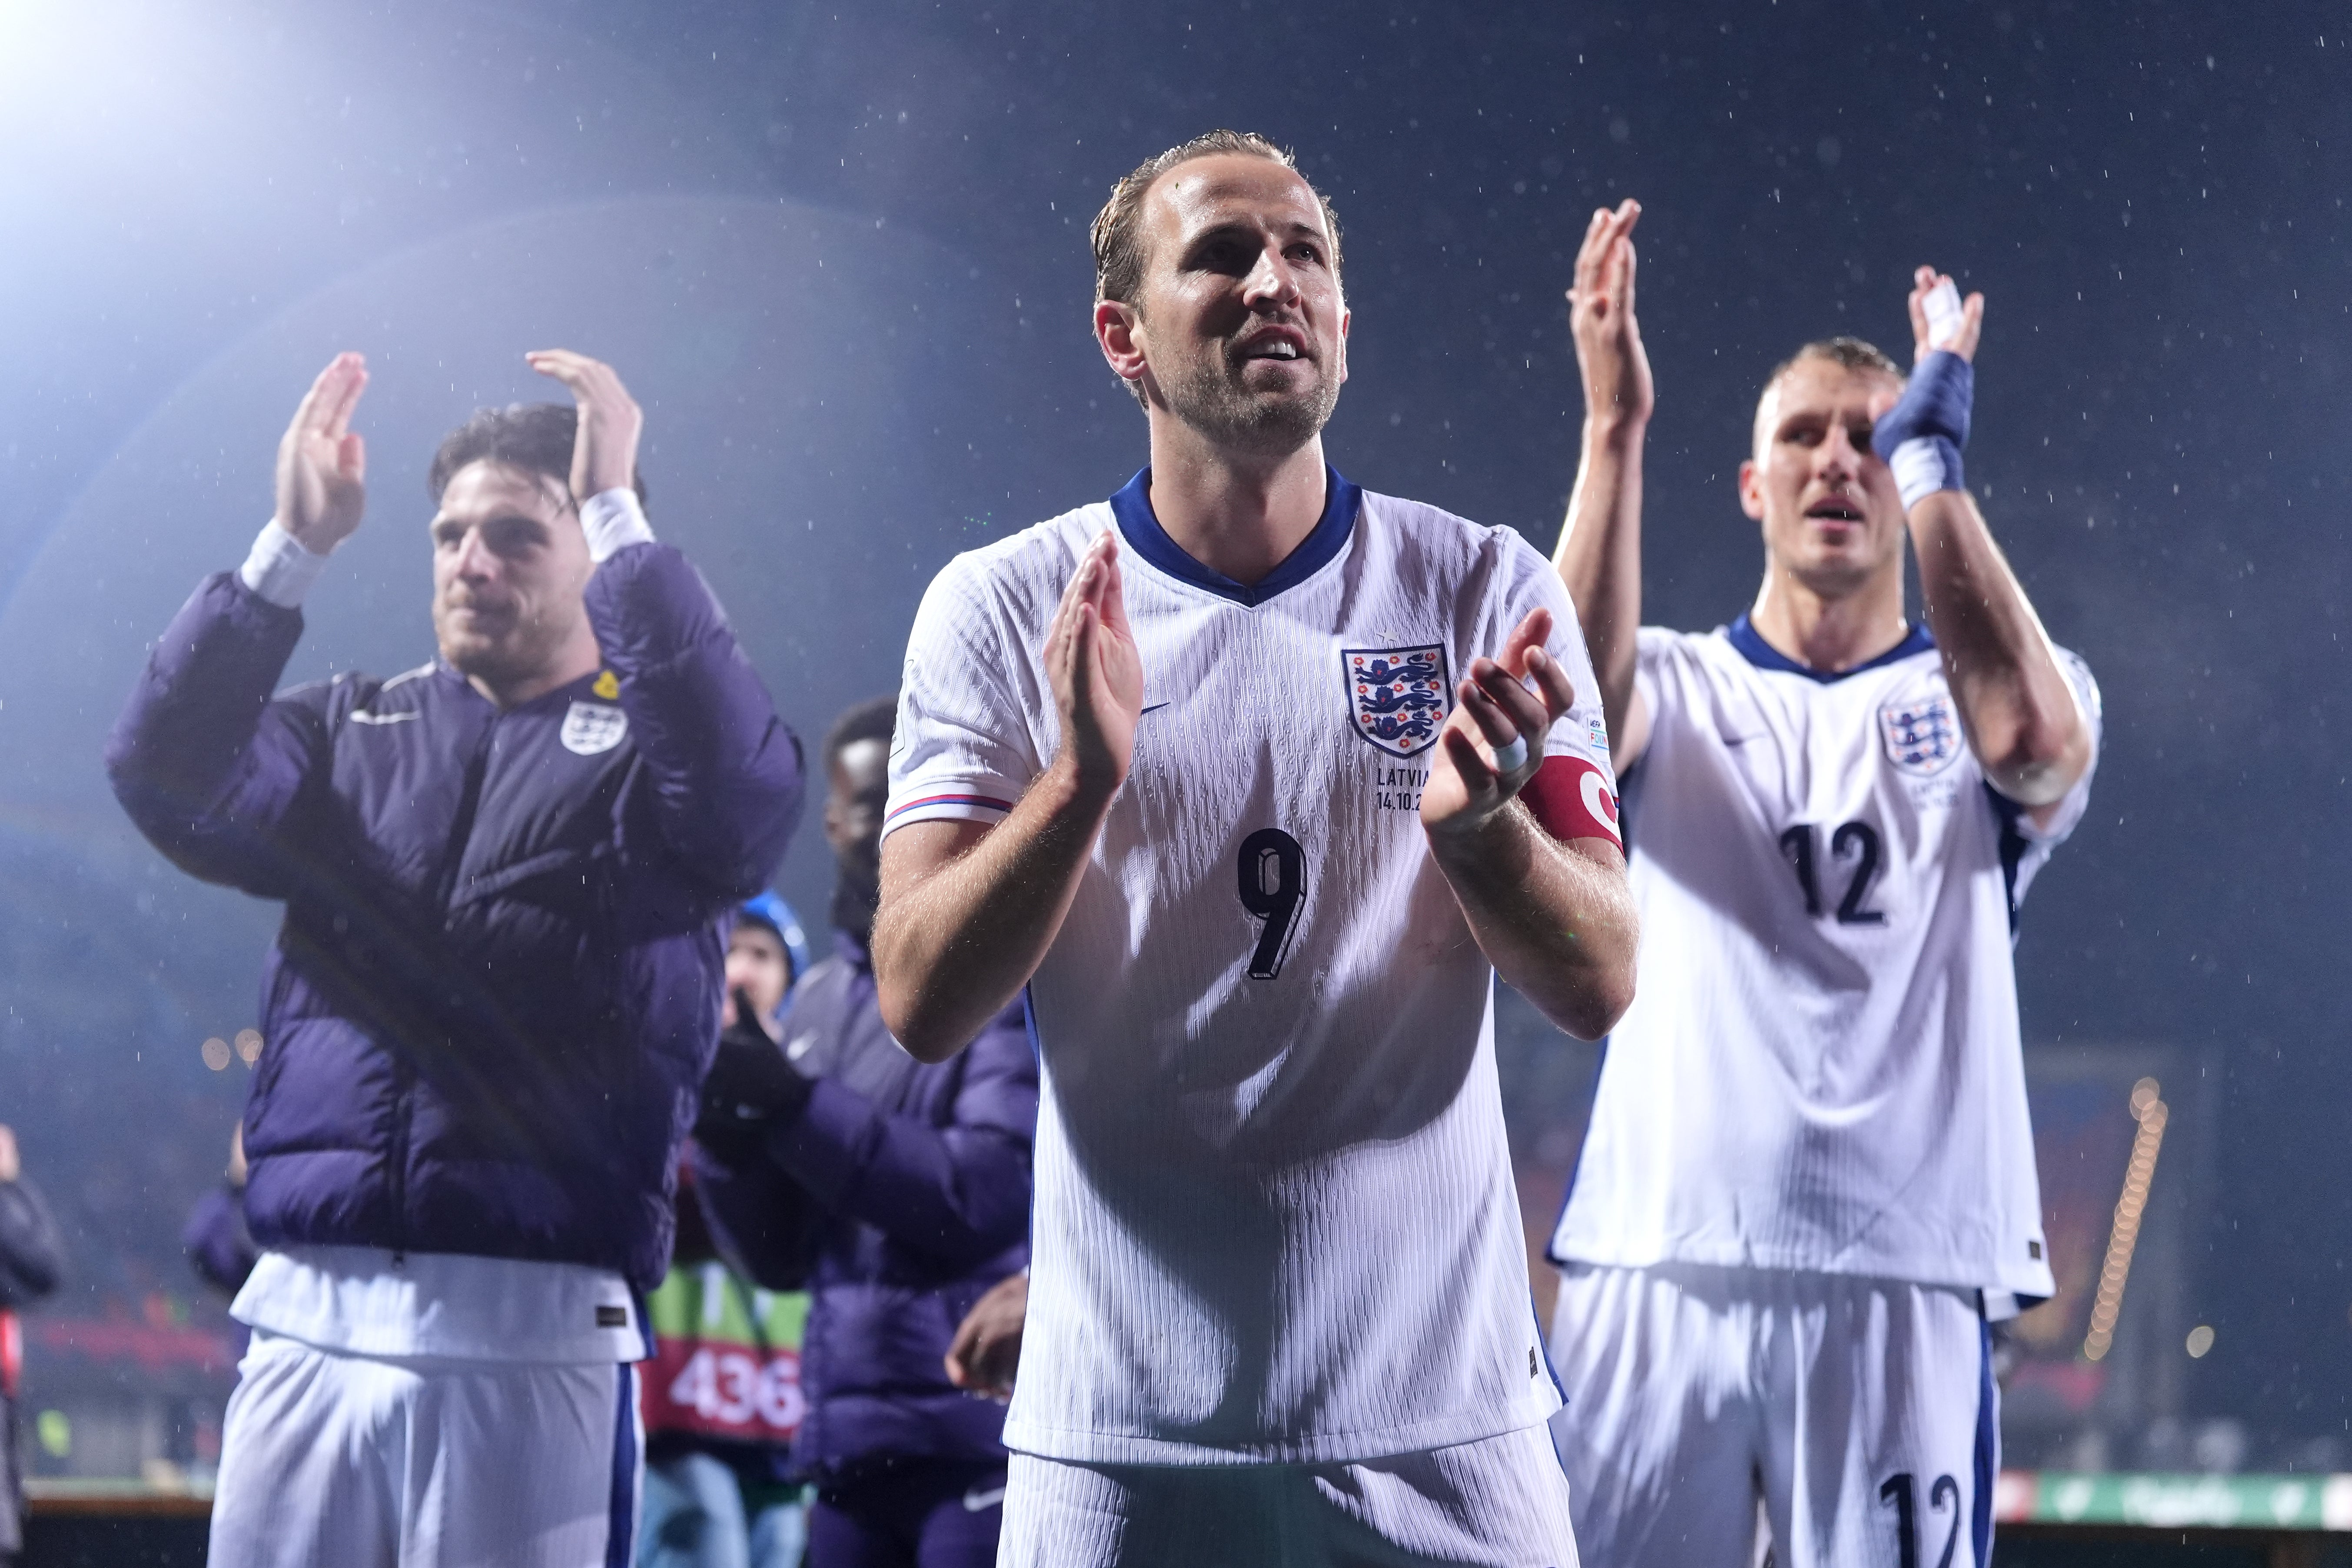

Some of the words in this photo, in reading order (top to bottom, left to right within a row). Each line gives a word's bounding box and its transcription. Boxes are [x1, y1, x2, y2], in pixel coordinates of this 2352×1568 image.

[1238, 828, 1307, 980] 9
[1780, 821, 1889, 927] 12
[670, 1349, 805, 1428] 436
[1880, 1472, 1961, 1568] 12
